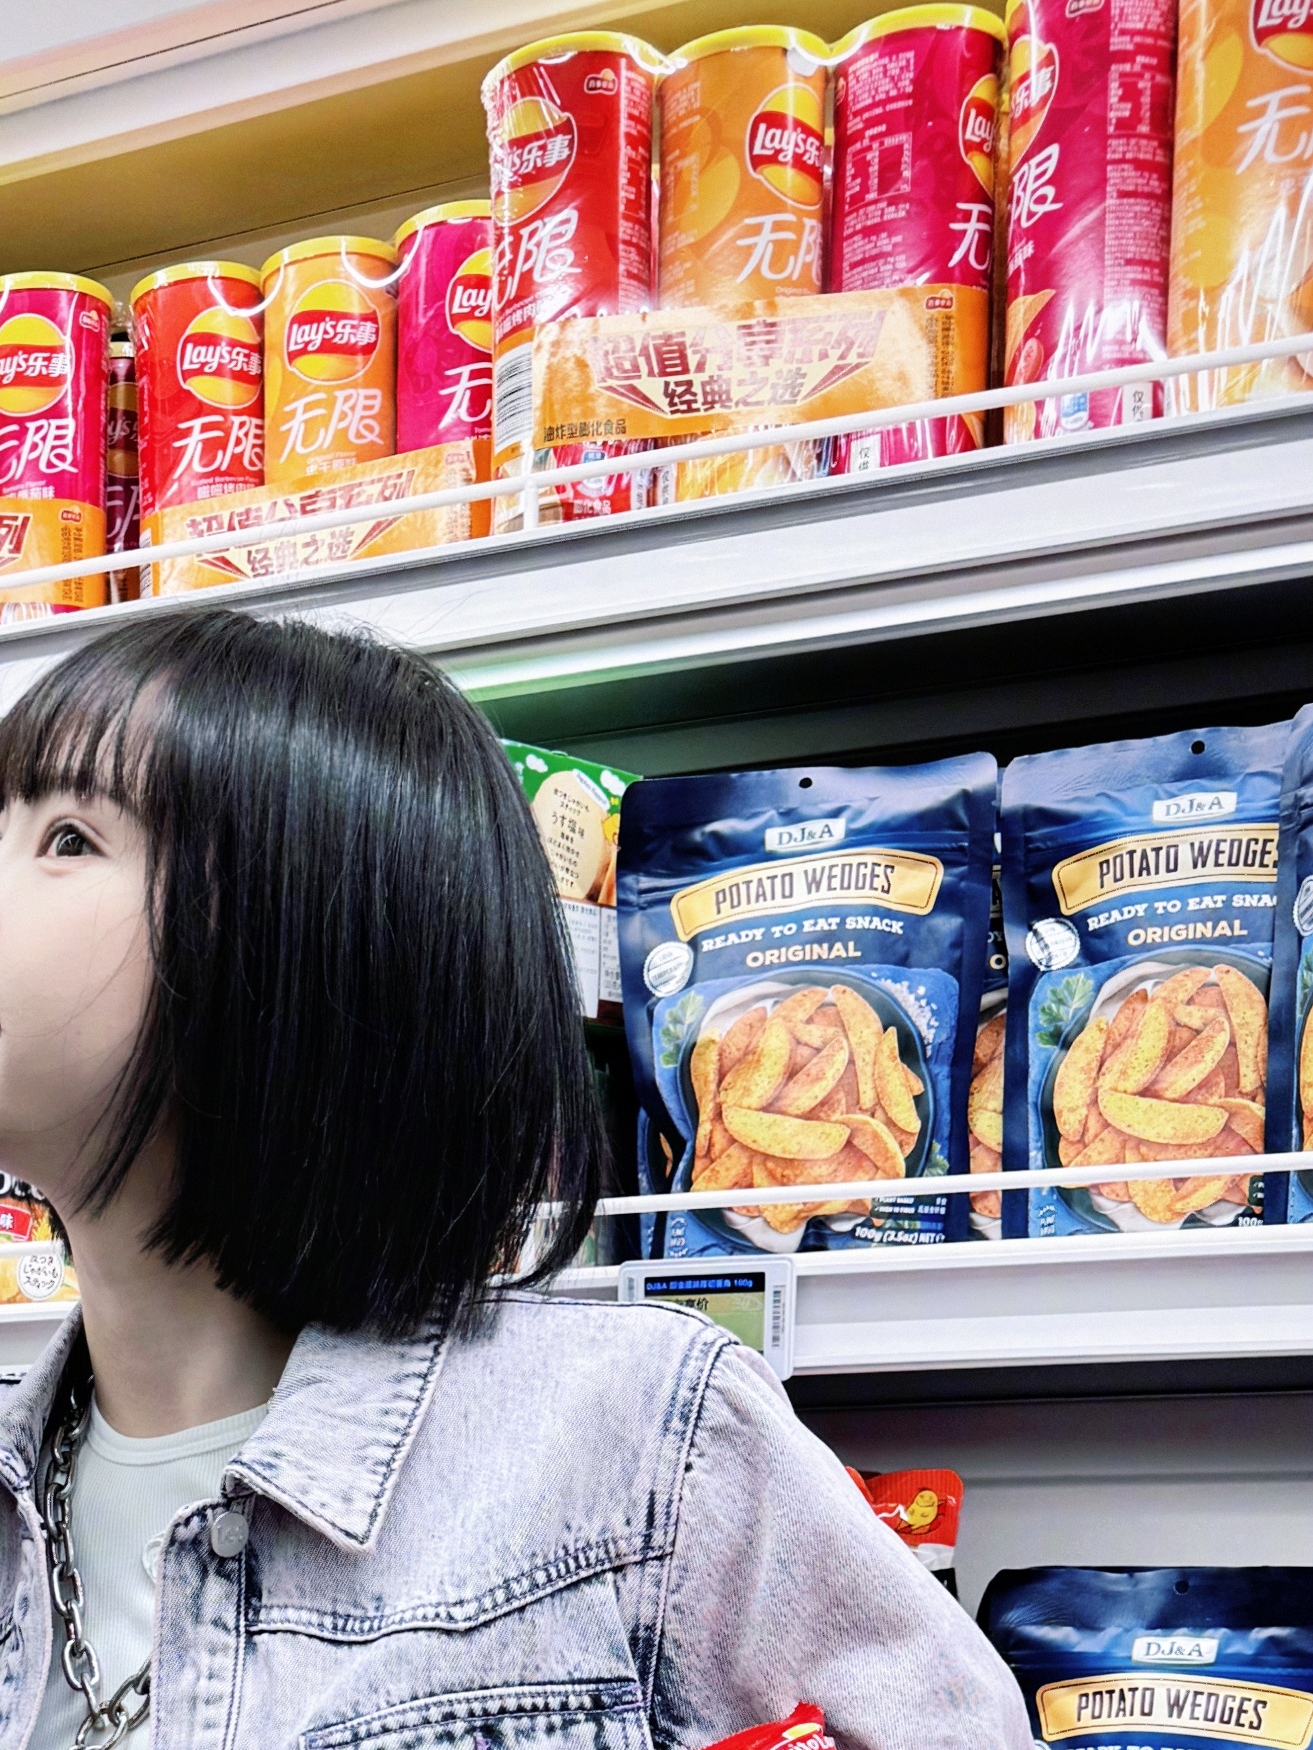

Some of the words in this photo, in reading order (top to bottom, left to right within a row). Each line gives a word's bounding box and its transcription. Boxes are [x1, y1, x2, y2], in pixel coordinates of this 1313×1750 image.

[753, 122, 824, 166] Lay's乐
[947, 201, 992, 271] 无
[288, 315, 380, 350] Lay's乐事
[439, 362, 493, 429] 无
[662, 367, 808, 416] 经典之选
[280, 387, 384, 465] 无限
[1164, 795, 1225, 819] DJ&A
[776, 823, 836, 848] DJ&A
[1099, 844, 1181, 890] POTATO
[1190, 836, 1279, 872] WEDGE
[713, 871, 795, 917] POTATO
[804, 862, 897, 897] WEDGES
[1087, 904, 1147, 932] READY
[1155, 899, 1182, 915] TO
[1187, 894, 1227, 910] EAT
[1232, 892, 1278, 909] SNA
[701, 925, 765, 953] READY
[771, 921, 798, 939] TO
[802, 916, 841, 935] EAT
[845, 914, 905, 936] SNACK
[746, 939, 862, 970] ORIGINAL
[1126, 920, 1249, 947] ORIGINAL
[1144, 1640, 1204, 1661] DJ&A
[1077, 1686, 1155, 1723] POTATO
[1165, 1688, 1269, 1732] WEDGES
